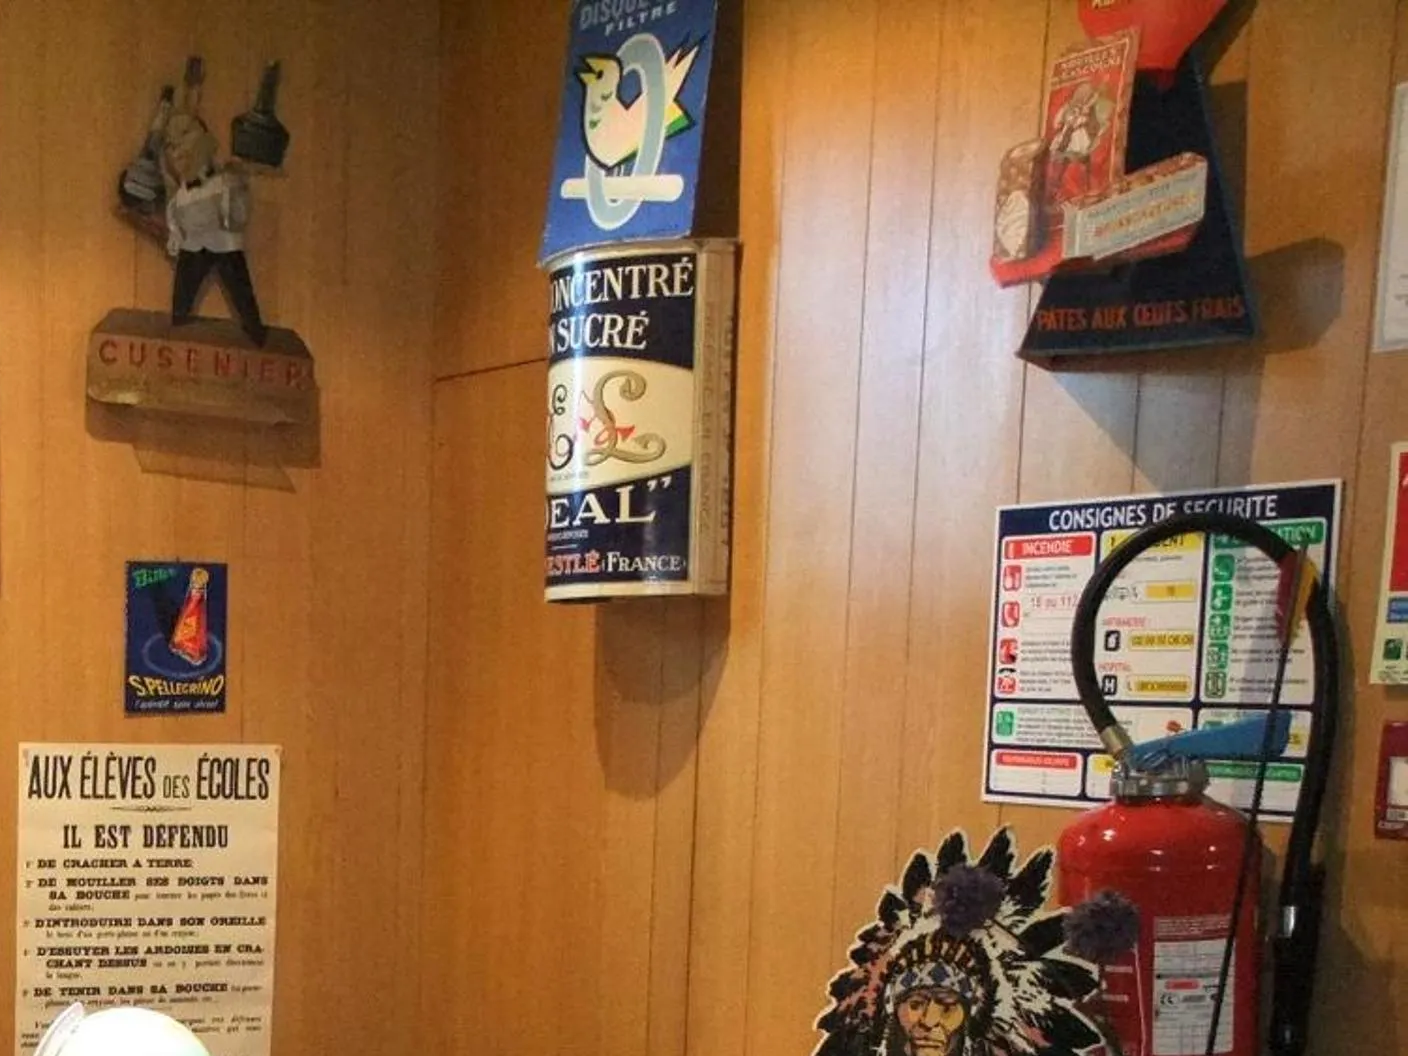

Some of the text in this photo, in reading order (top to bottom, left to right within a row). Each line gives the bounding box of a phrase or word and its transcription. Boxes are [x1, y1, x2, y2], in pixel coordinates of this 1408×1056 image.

[1093, 304, 1127, 327] AUX
[99, 339, 310, 391] CUSENIER
[1049, 503, 1148, 530] CONSIGNES
[28, 751, 270, 800] AUX ÉLÈVES DES ÉCOLES
[63, 824, 81, 849] IL
[95, 824, 132, 849] EST
[37, 859, 57, 869] DE
[63, 859, 127, 869] CRACHER
[38, 878, 57, 888] DE
[66, 877, 137, 888] MOUILLER
[146, 877, 169, 887] SES
[177, 877, 225, 887] DOIGTS
[234, 876, 268, 886] DANS
[48, 890, 67, 900] SA
[75, 890, 131, 900] BOUCHE
[137, 917, 173, 927] DANS
[180, 916, 205, 926] SON
[210, 916, 266, 926] OREILLE
[114, 946, 138, 956] LES
[144, 945, 209, 955] ARDOISES
[214, 944, 232, 954] EN
[46, 959, 92, 969] CHANT
[98, 958, 147, 968] DESSUS
[34, 987, 53, 997] DE
[59, 987, 101, 997] TENIR
[108, 985, 144, 995] DANS
[150, 985, 168, 995] SA
[175, 983, 229, 994] BOUCHE
